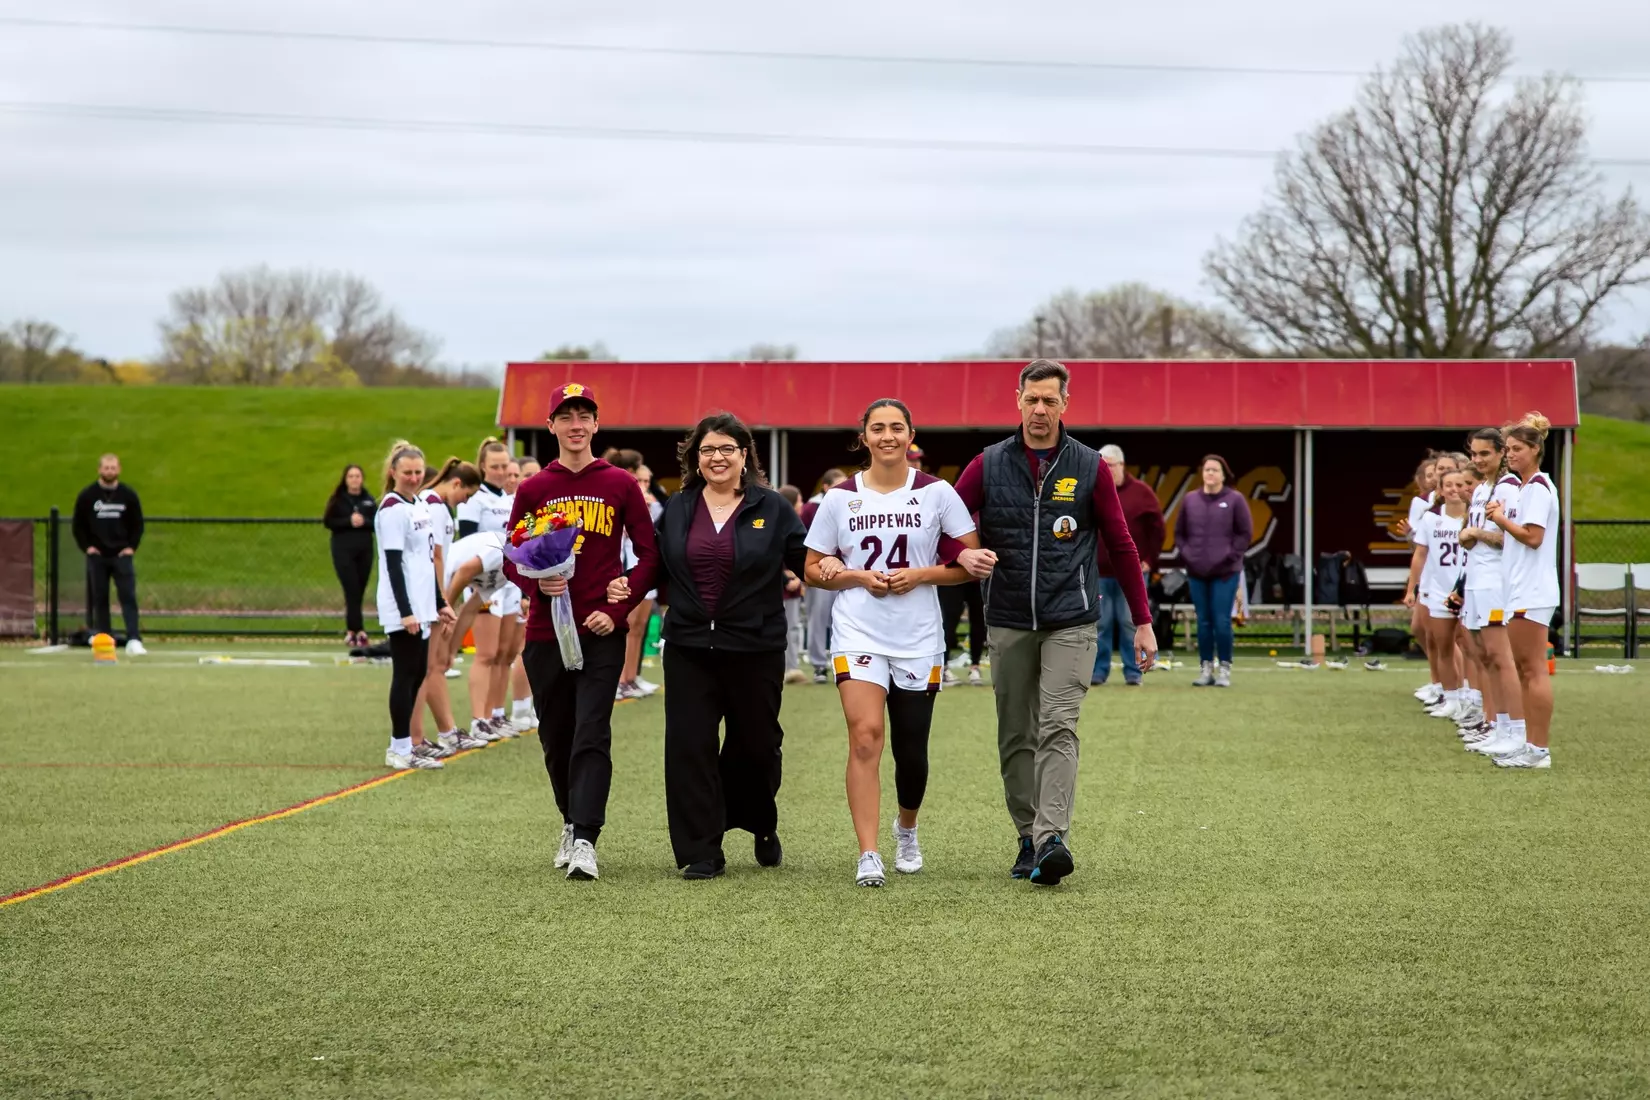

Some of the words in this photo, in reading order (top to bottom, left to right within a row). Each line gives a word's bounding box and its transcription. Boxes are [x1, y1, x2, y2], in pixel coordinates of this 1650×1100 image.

[536, 500, 615, 537] PPEWAS
[848, 513, 922, 532] CHIPPEWAS
[860, 534, 910, 573] 24
